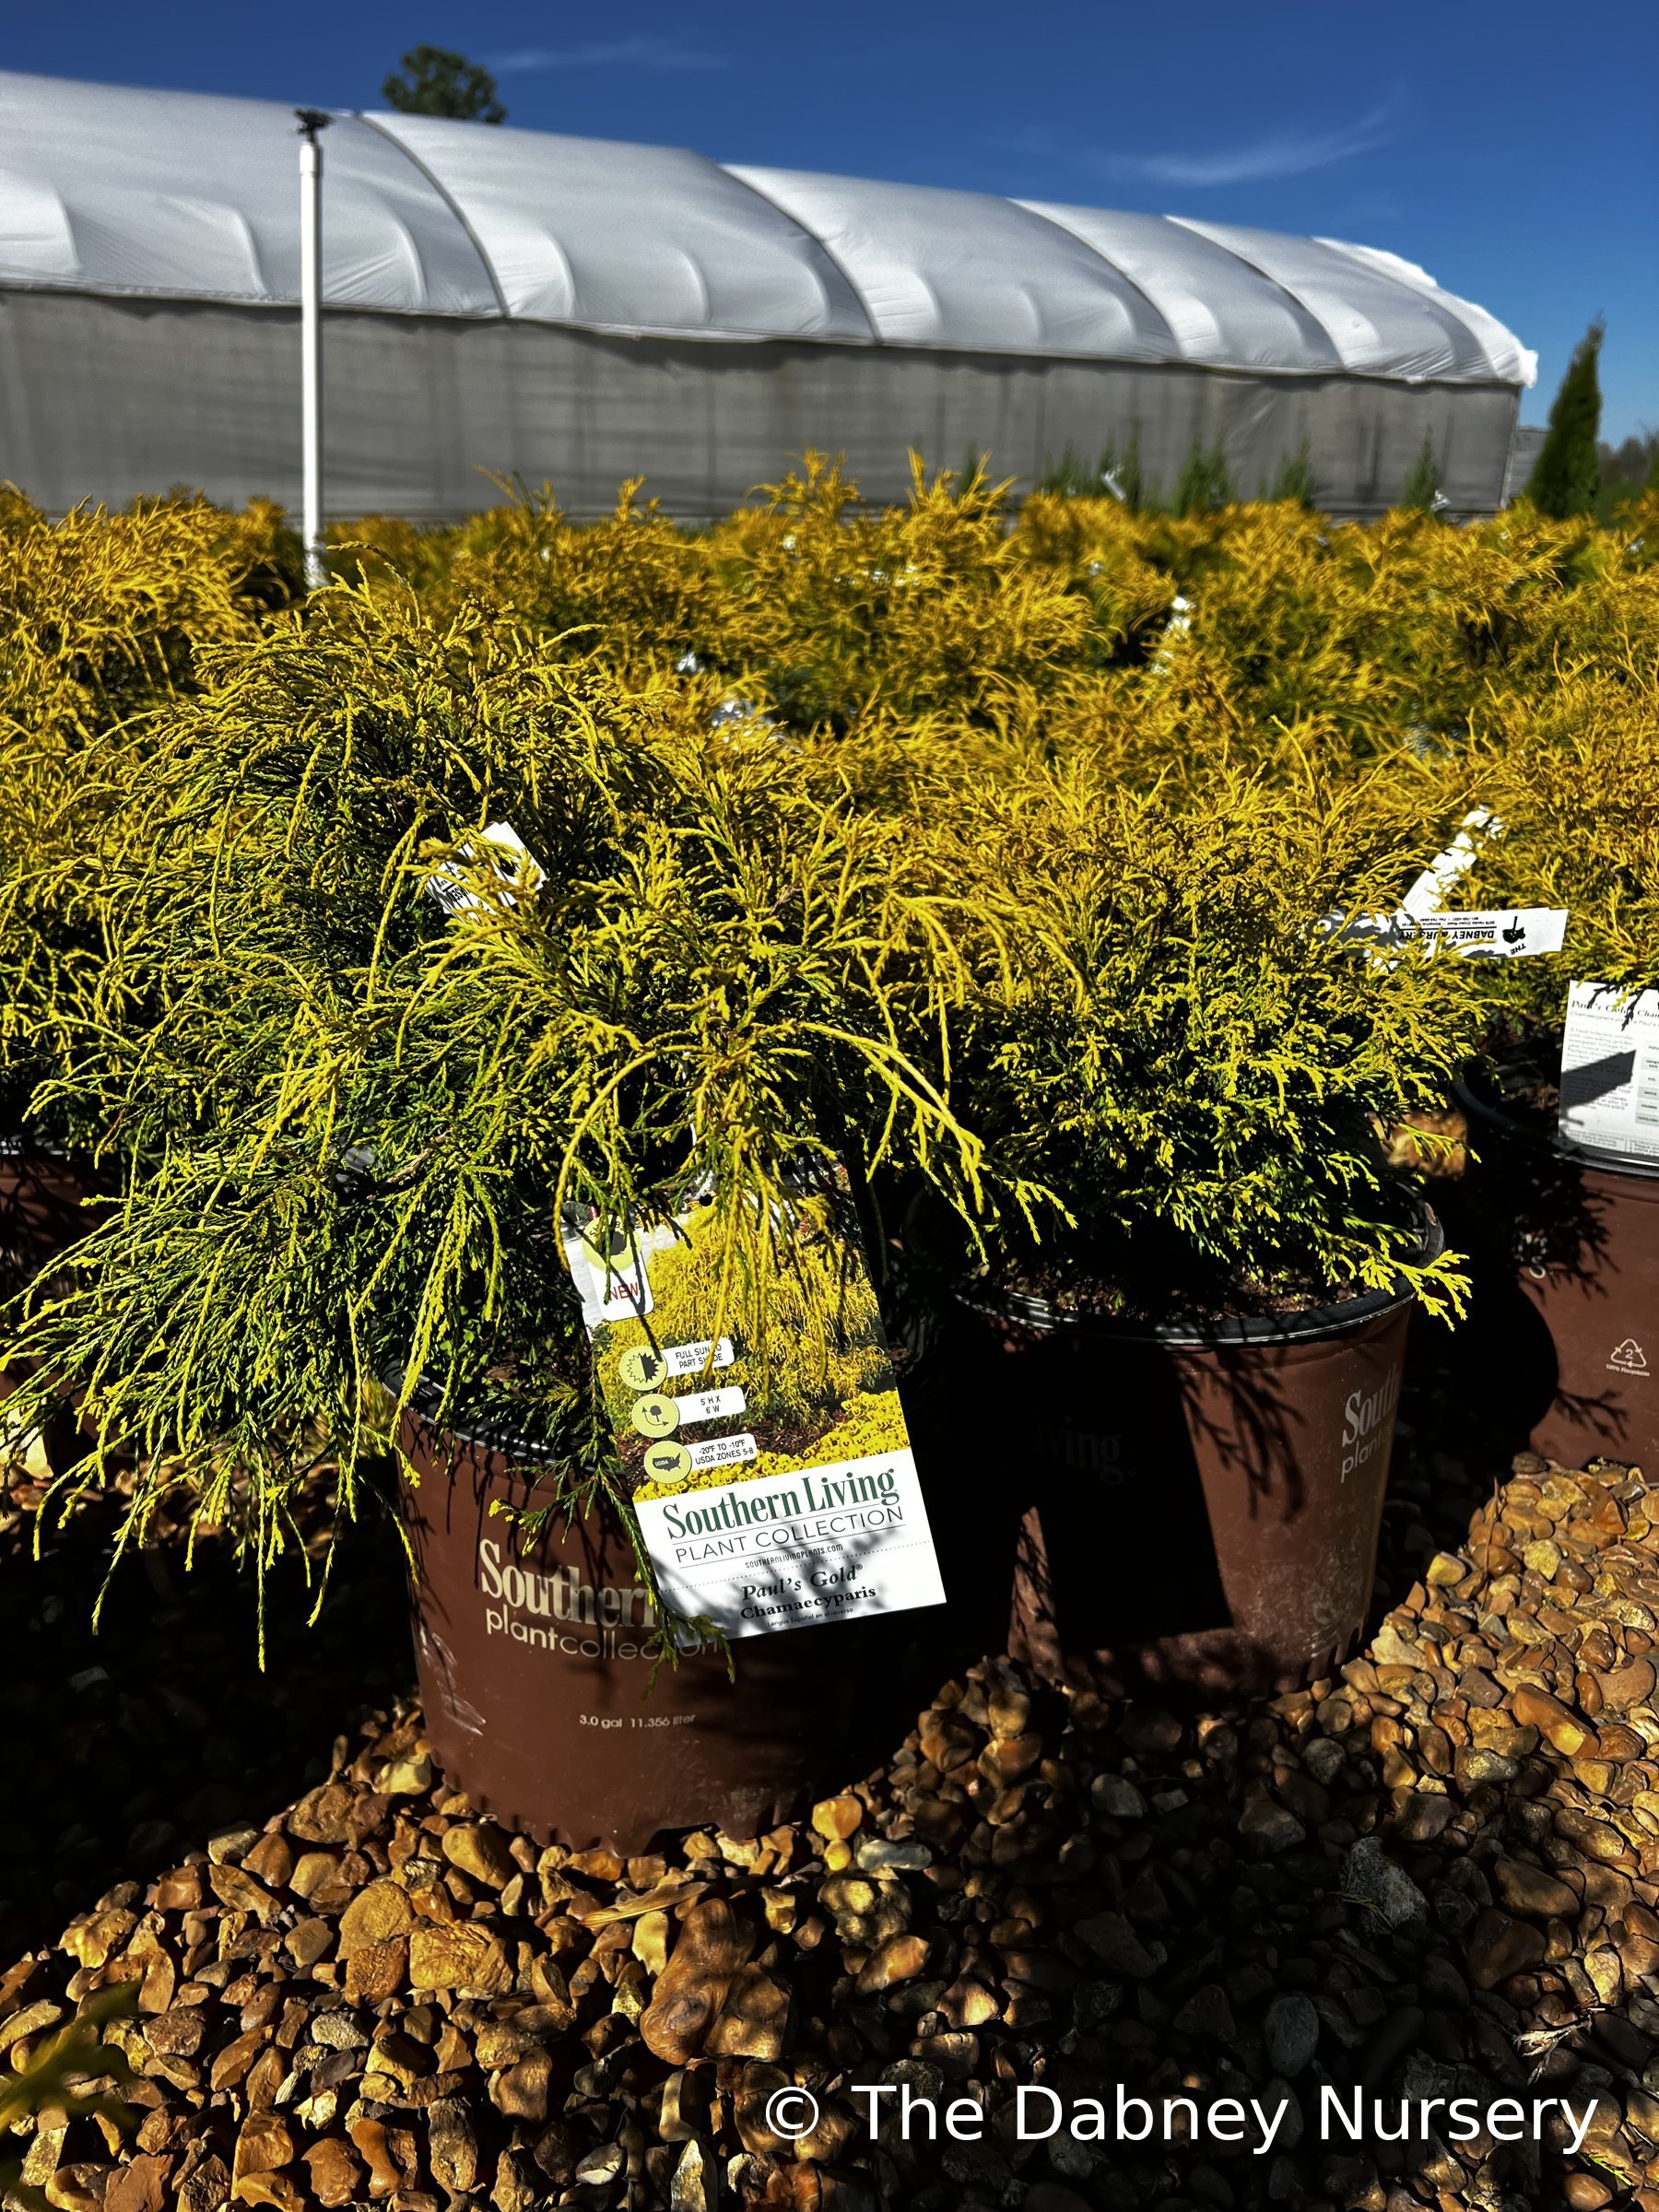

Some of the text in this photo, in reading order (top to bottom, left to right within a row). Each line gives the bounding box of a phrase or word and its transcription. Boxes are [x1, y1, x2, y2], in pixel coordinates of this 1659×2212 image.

[1452, 930, 1495, 940] DABNEY
[1510, 943, 1526, 956] THE
[609, 1282, 639, 1301] NEW
[675, 1350, 693, 1360] FULL
[694, 1346, 711, 1356] SUN
[678, 1353, 724, 1369] PART SHDE
[1625, 1348, 1633, 1359] 2
[715, 1394, 722, 1403] X
[712, 1405, 720, 1413] W
[717, 1442, 727, 1452] TO
[695, 1447, 754, 1465] USDA ZONES 5-8
[663, 1468, 900, 1539] Southern Living
[676, 1506, 904, 1563] PLANT COLLECTION
[741, 1577, 802, 1601] Paul's
[740, 1586, 877, 1619] Chamaecyparis
[579, 1713, 696, 1729] 3.0 gal 11.356 liter
